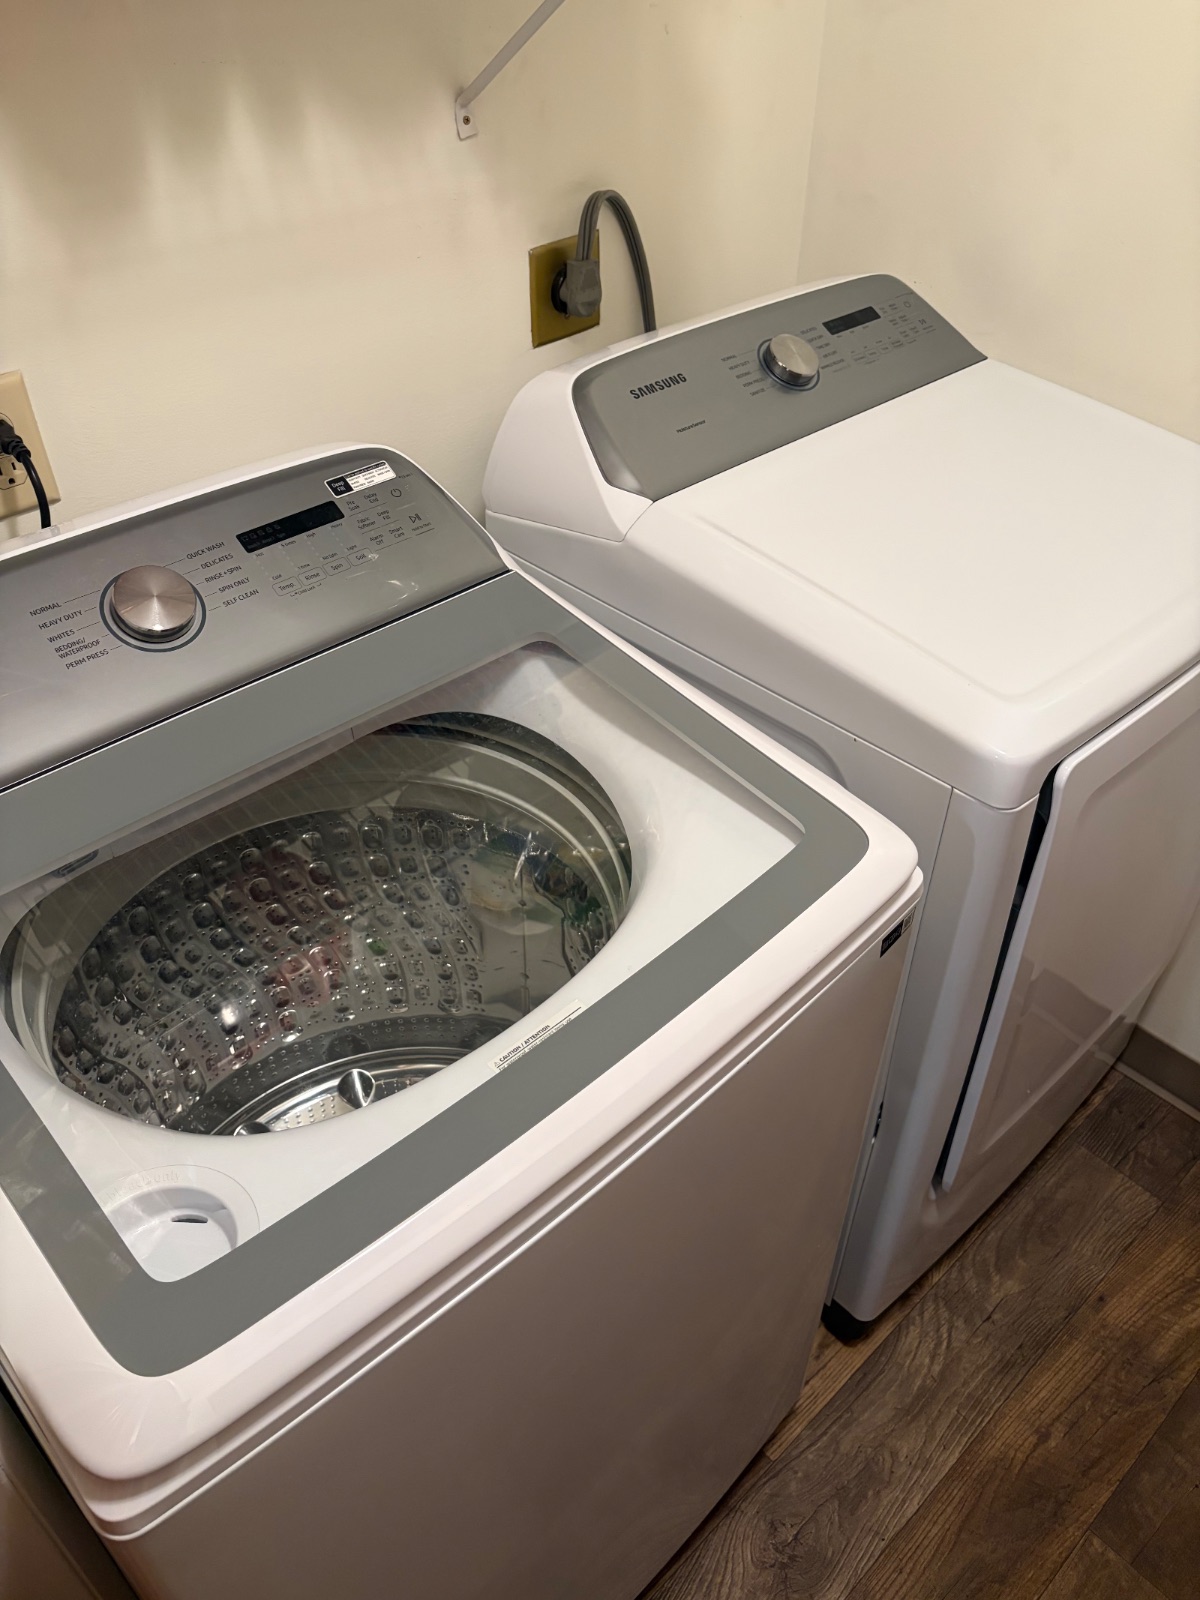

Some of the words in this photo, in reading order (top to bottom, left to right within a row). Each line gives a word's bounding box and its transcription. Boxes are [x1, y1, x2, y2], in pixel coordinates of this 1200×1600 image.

[629, 373, 688, 400] SAMSUNG
[331, 480, 345, 488] Deep
[186, 548, 206, 560] QUICK
[205, 541, 226, 553] WASH
[200, 553, 234, 570] DELICATES
[331, 563, 344, 571] Spin
[218, 582, 234, 594] SPIN
[233, 576, 250, 587] ONLY
[304, 572, 321, 581] Rinse
[222, 596, 238, 608] SELF
[238, 588, 260, 601] CLEAN
[29, 602, 62, 617] NORMAL
[38, 616, 63, 630] HEAVY
[63, 609, 83, 622] DUTY
[46, 628, 76, 643] WHITES
[54, 636, 86, 653] BEDDING/
[58, 638, 101, 660] WATERPROOF
[65, 657, 87, 670] PERM
[86, 648, 110, 662] PRESS
[499, 1045, 522, 1063] CAUTION
[524, 1024, 551, 1045] ATTENTION
